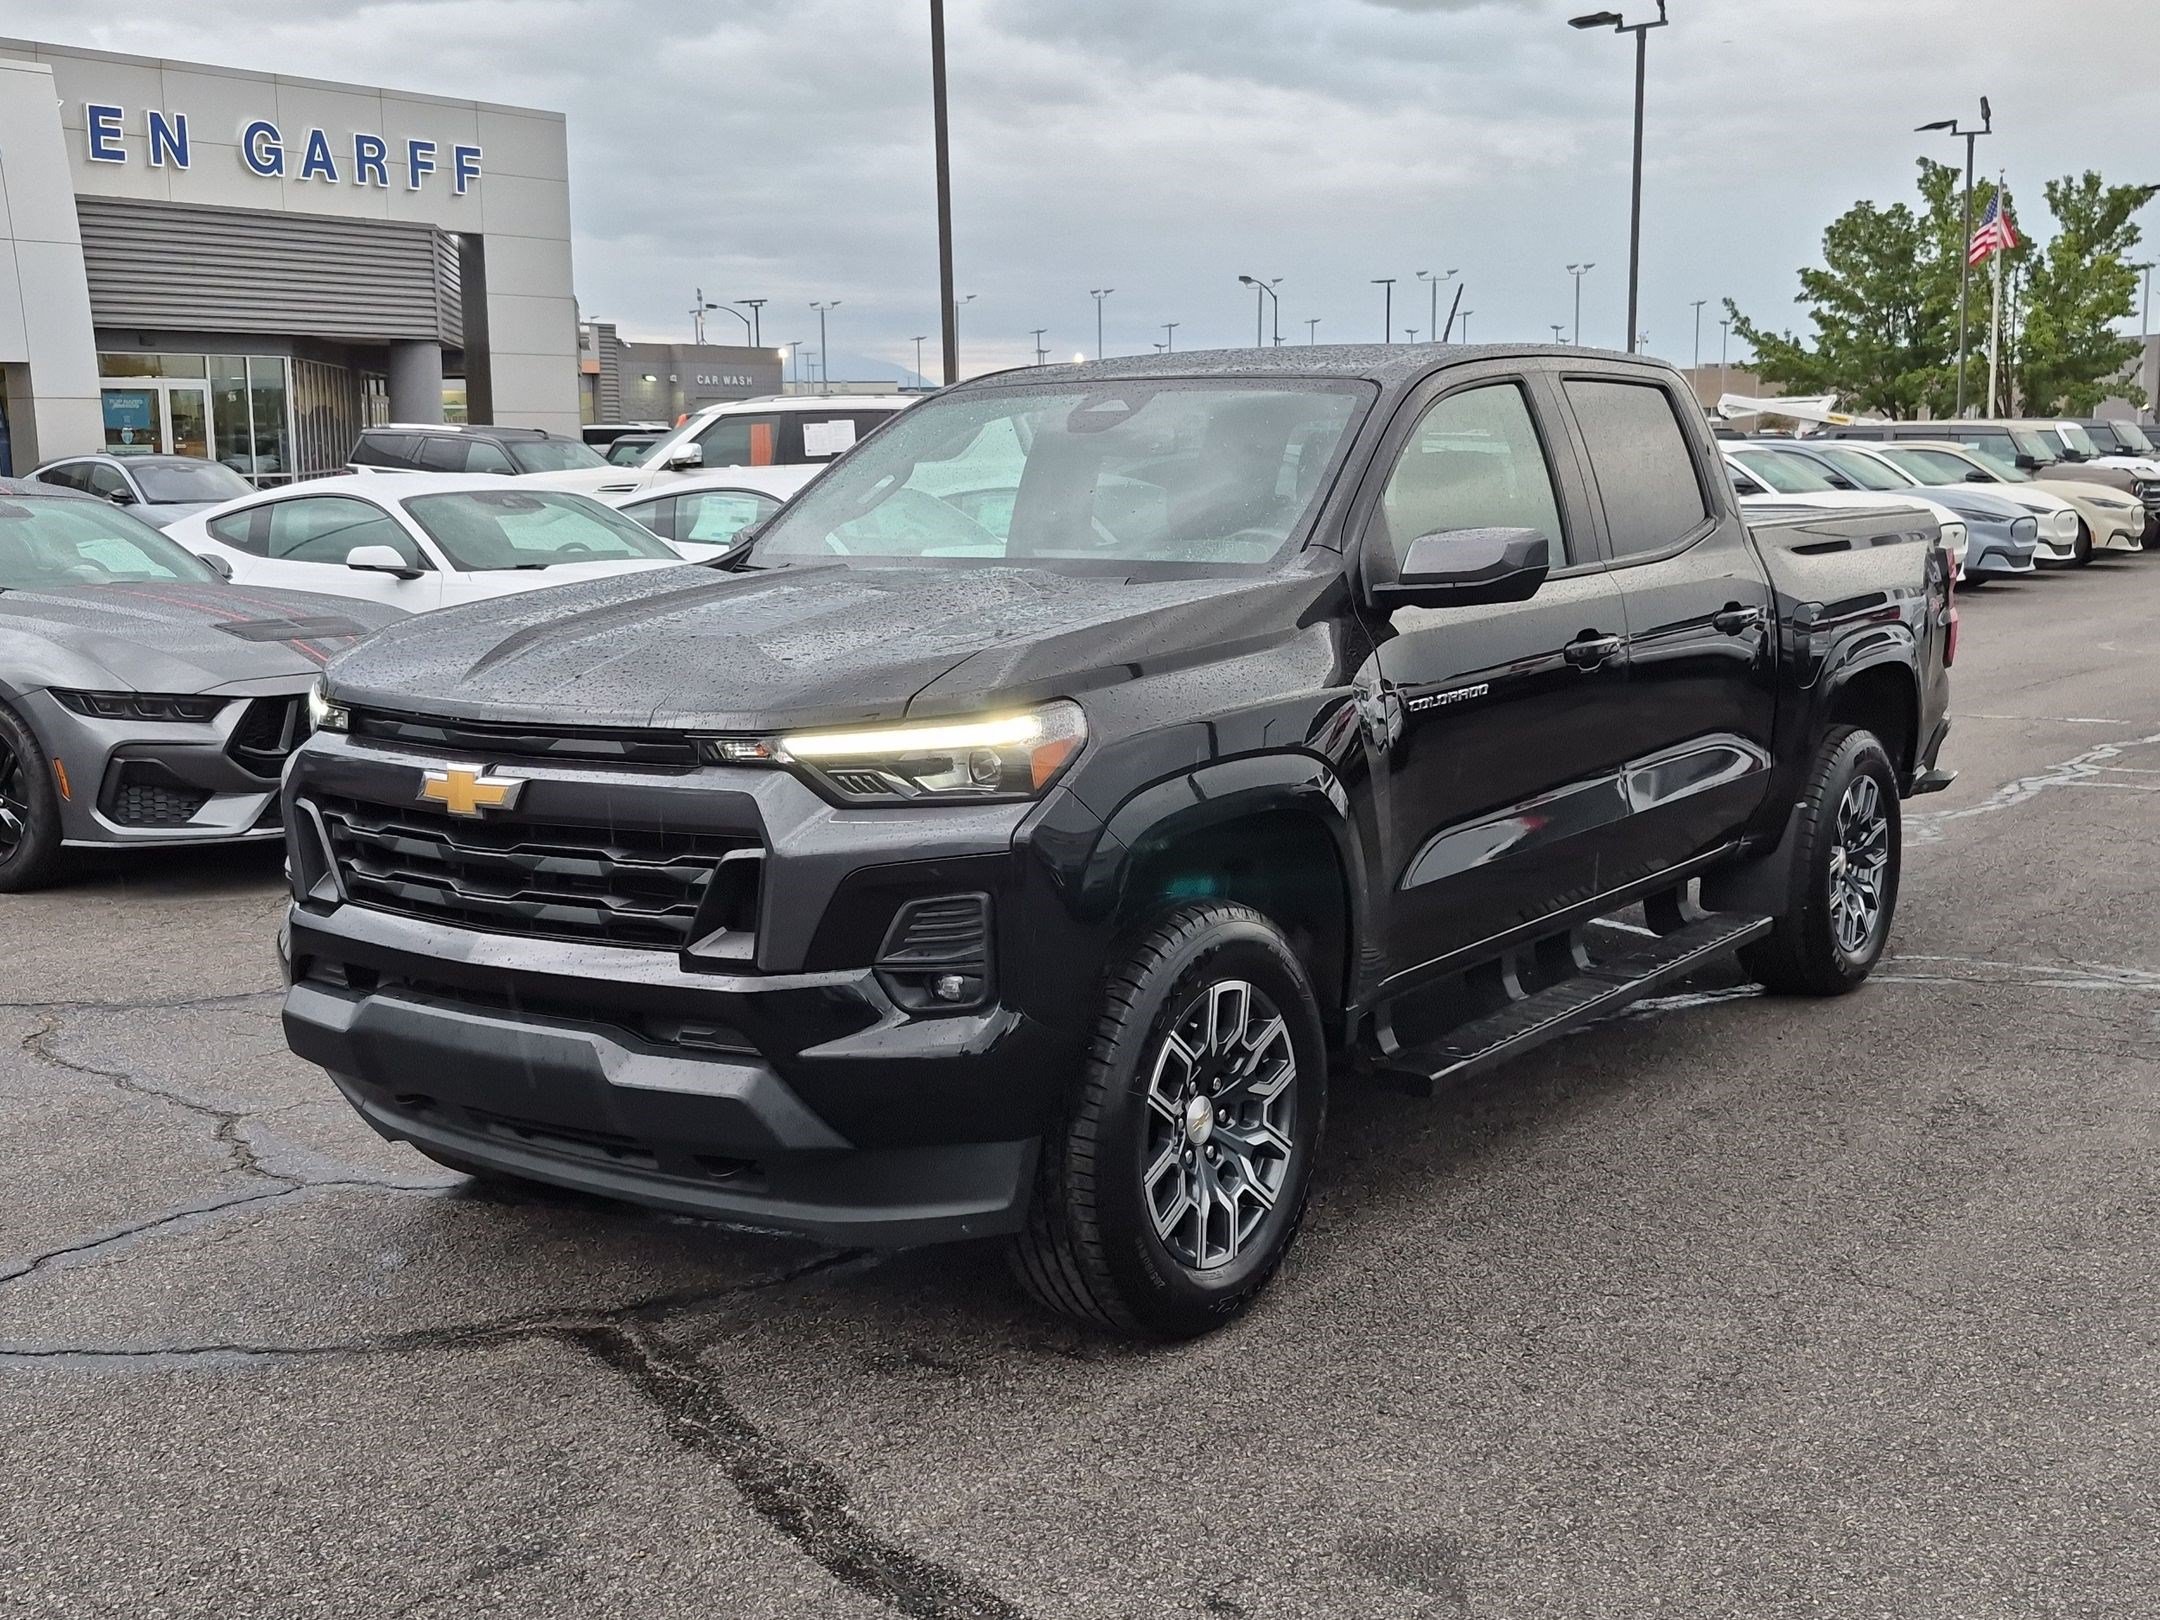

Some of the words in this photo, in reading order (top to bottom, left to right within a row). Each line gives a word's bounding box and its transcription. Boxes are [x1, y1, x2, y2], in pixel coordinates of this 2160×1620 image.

[58, 100, 191, 170] EN
[242, 119, 483, 195] GARFF
[697, 374, 719, 385] CAR
[723, 375, 753, 386] WASH
[1408, 683, 1489, 712] COLORADO
